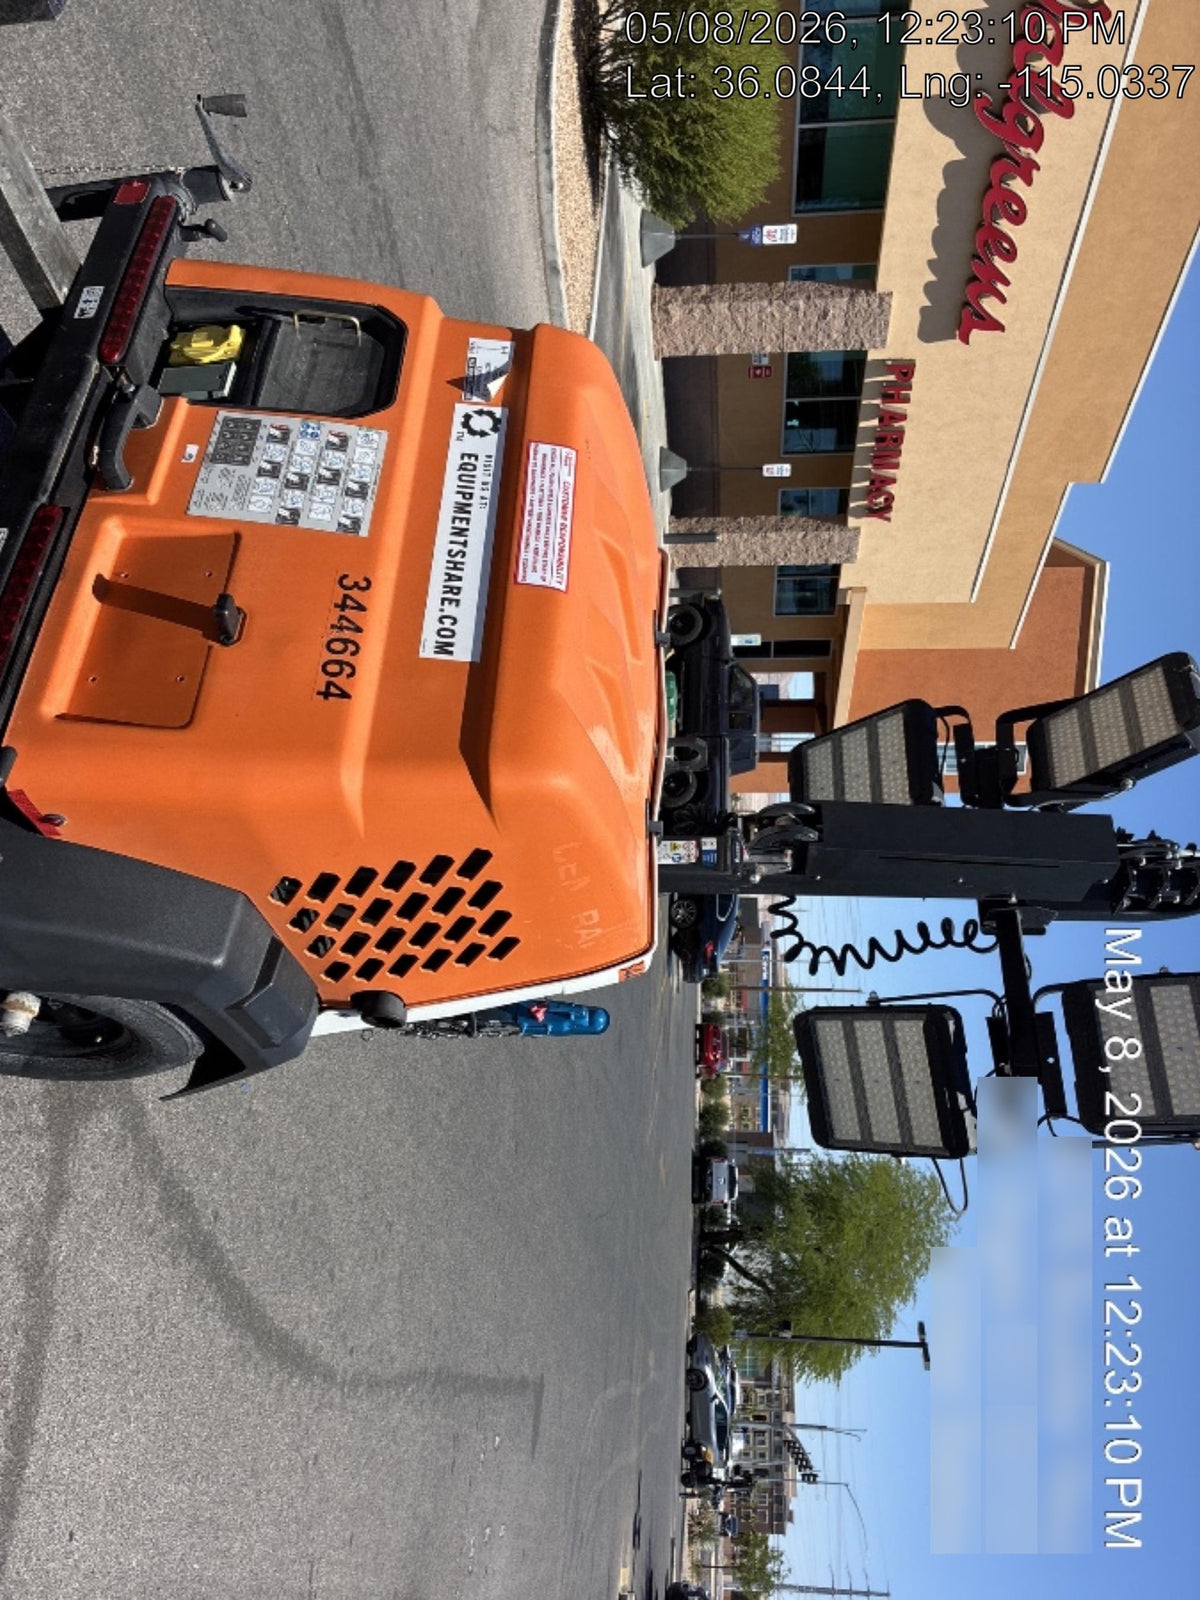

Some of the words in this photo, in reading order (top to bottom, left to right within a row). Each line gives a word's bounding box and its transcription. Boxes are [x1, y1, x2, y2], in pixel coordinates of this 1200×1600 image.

[480, 481, 490, 492] US
[481, 454, 493, 477] VISIT
[865, 360, 916, 522] PHARMACY
[433, 452, 479, 657] EQUIPMENTSHARE.COM
[316, 573, 372, 701] 344664
